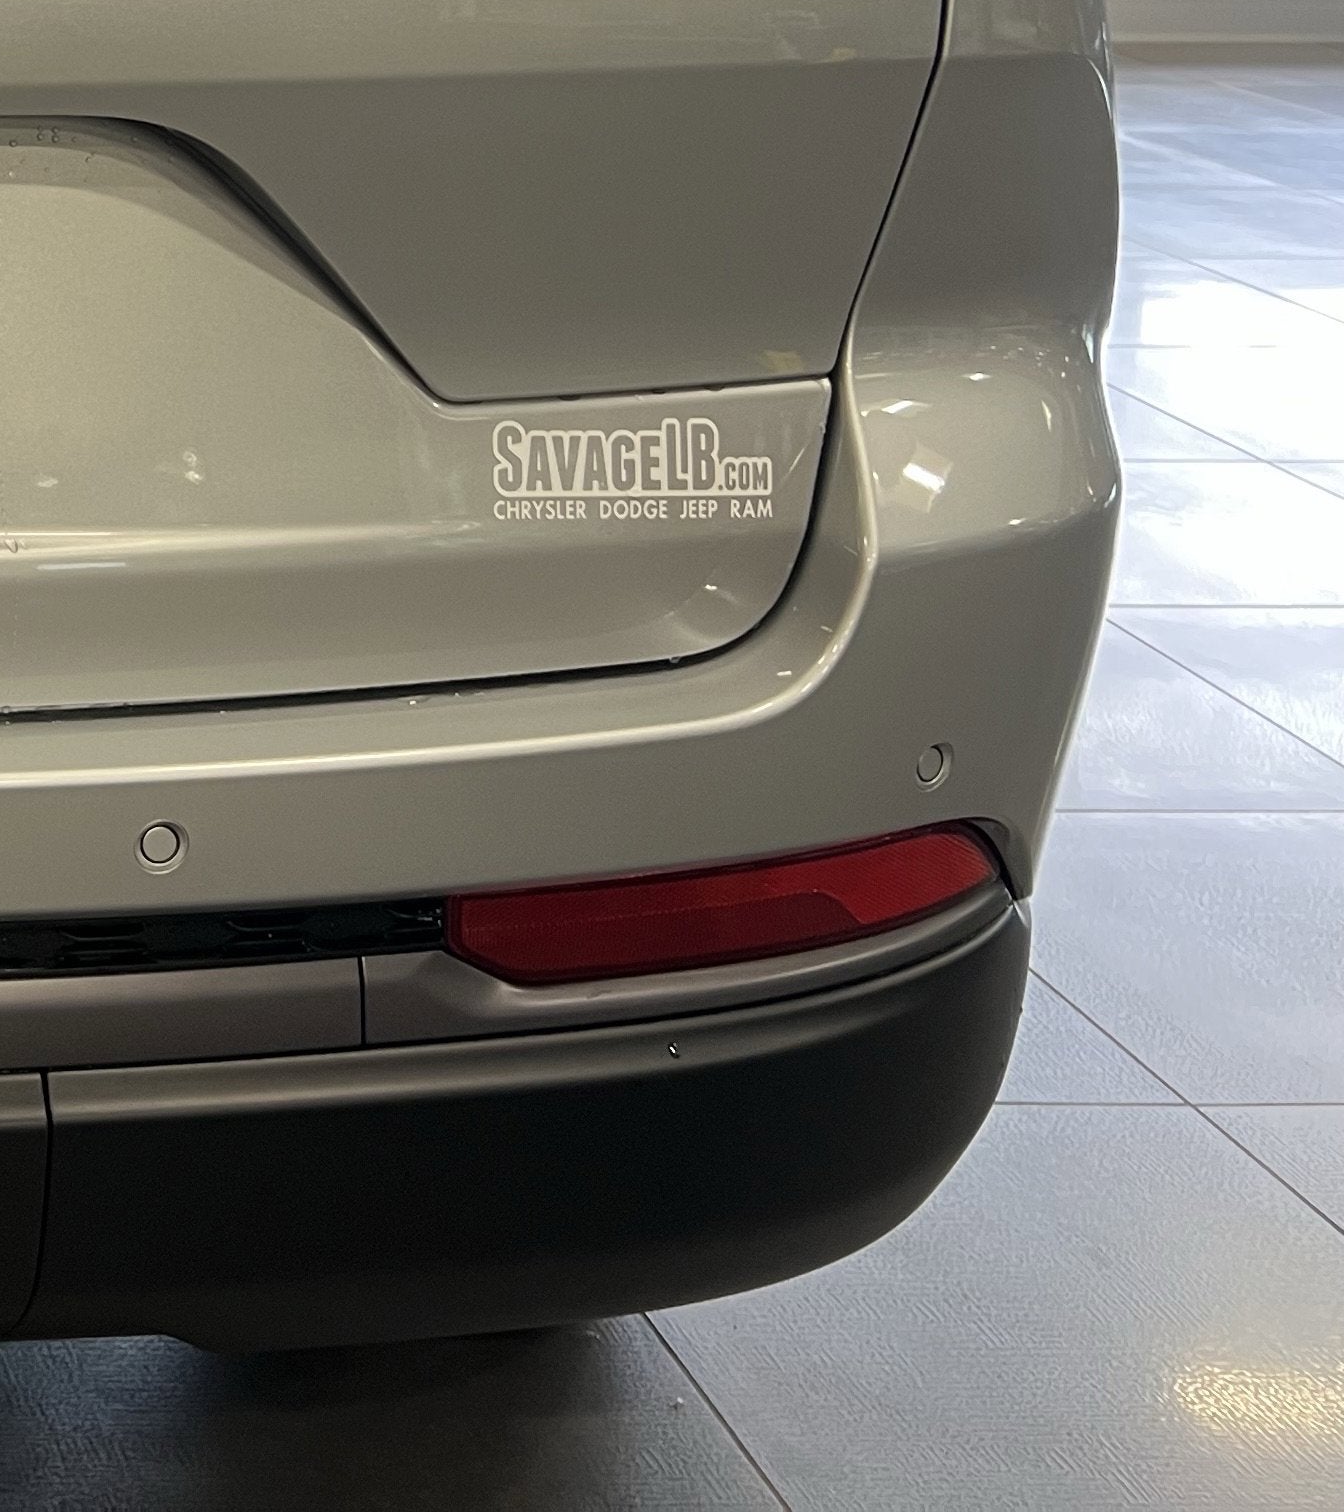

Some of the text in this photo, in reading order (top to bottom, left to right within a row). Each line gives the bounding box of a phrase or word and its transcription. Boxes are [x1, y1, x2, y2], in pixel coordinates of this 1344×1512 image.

[493, 499, 773, 520] CHRYSLER DODGE JEEP RAM
